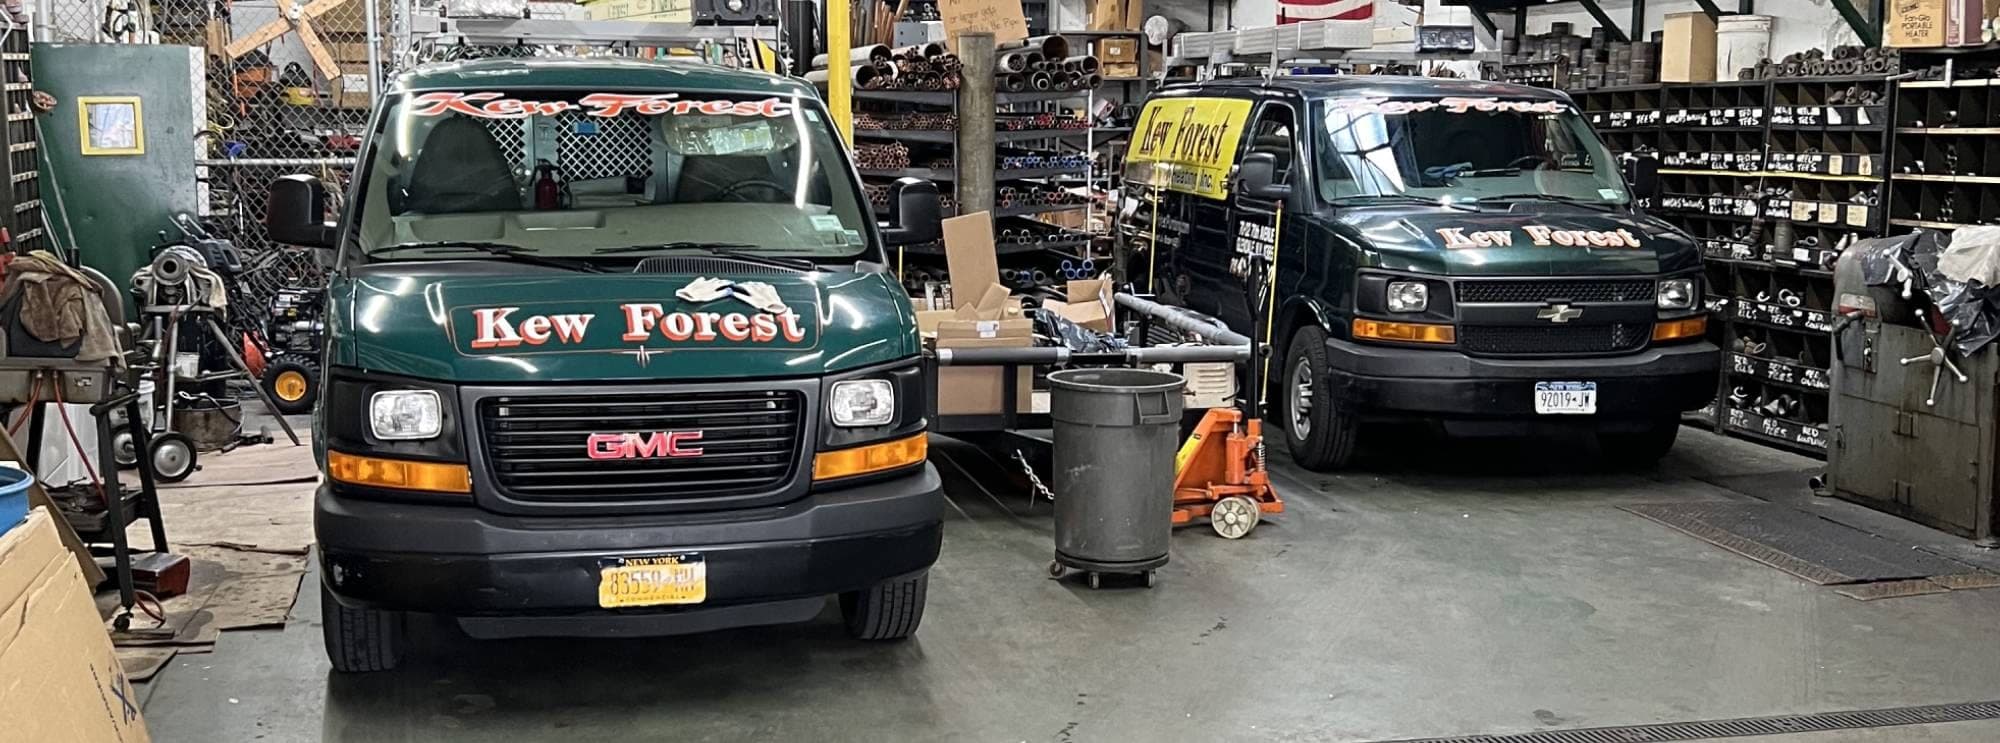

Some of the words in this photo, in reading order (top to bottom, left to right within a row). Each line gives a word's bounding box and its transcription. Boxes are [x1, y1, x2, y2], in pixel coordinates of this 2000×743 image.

[1901, 22, 1933, 30] PORTABLE
[1905, 30, 1929, 38] HEATER
[408, 92, 580, 118] Kew
[578, 92, 792, 118] Forest
[1333, 97, 1439, 115] Kew
[1438, 96, 1568, 113] Forest
[1139, 106, 1173, 155] Kew
[1170, 105, 1232, 166] Forest
[1435, 226, 1513, 250] Kew
[1521, 223, 1641, 249] Forest
[471, 306, 596, 349] Kew
[619, 302, 807, 343] Forest
[1802, 425, 1820, 437] RED
[586, 429, 704, 460] GMC
[625, 557, 651, 568] NEW
[651, 555, 680, 566] YORK
